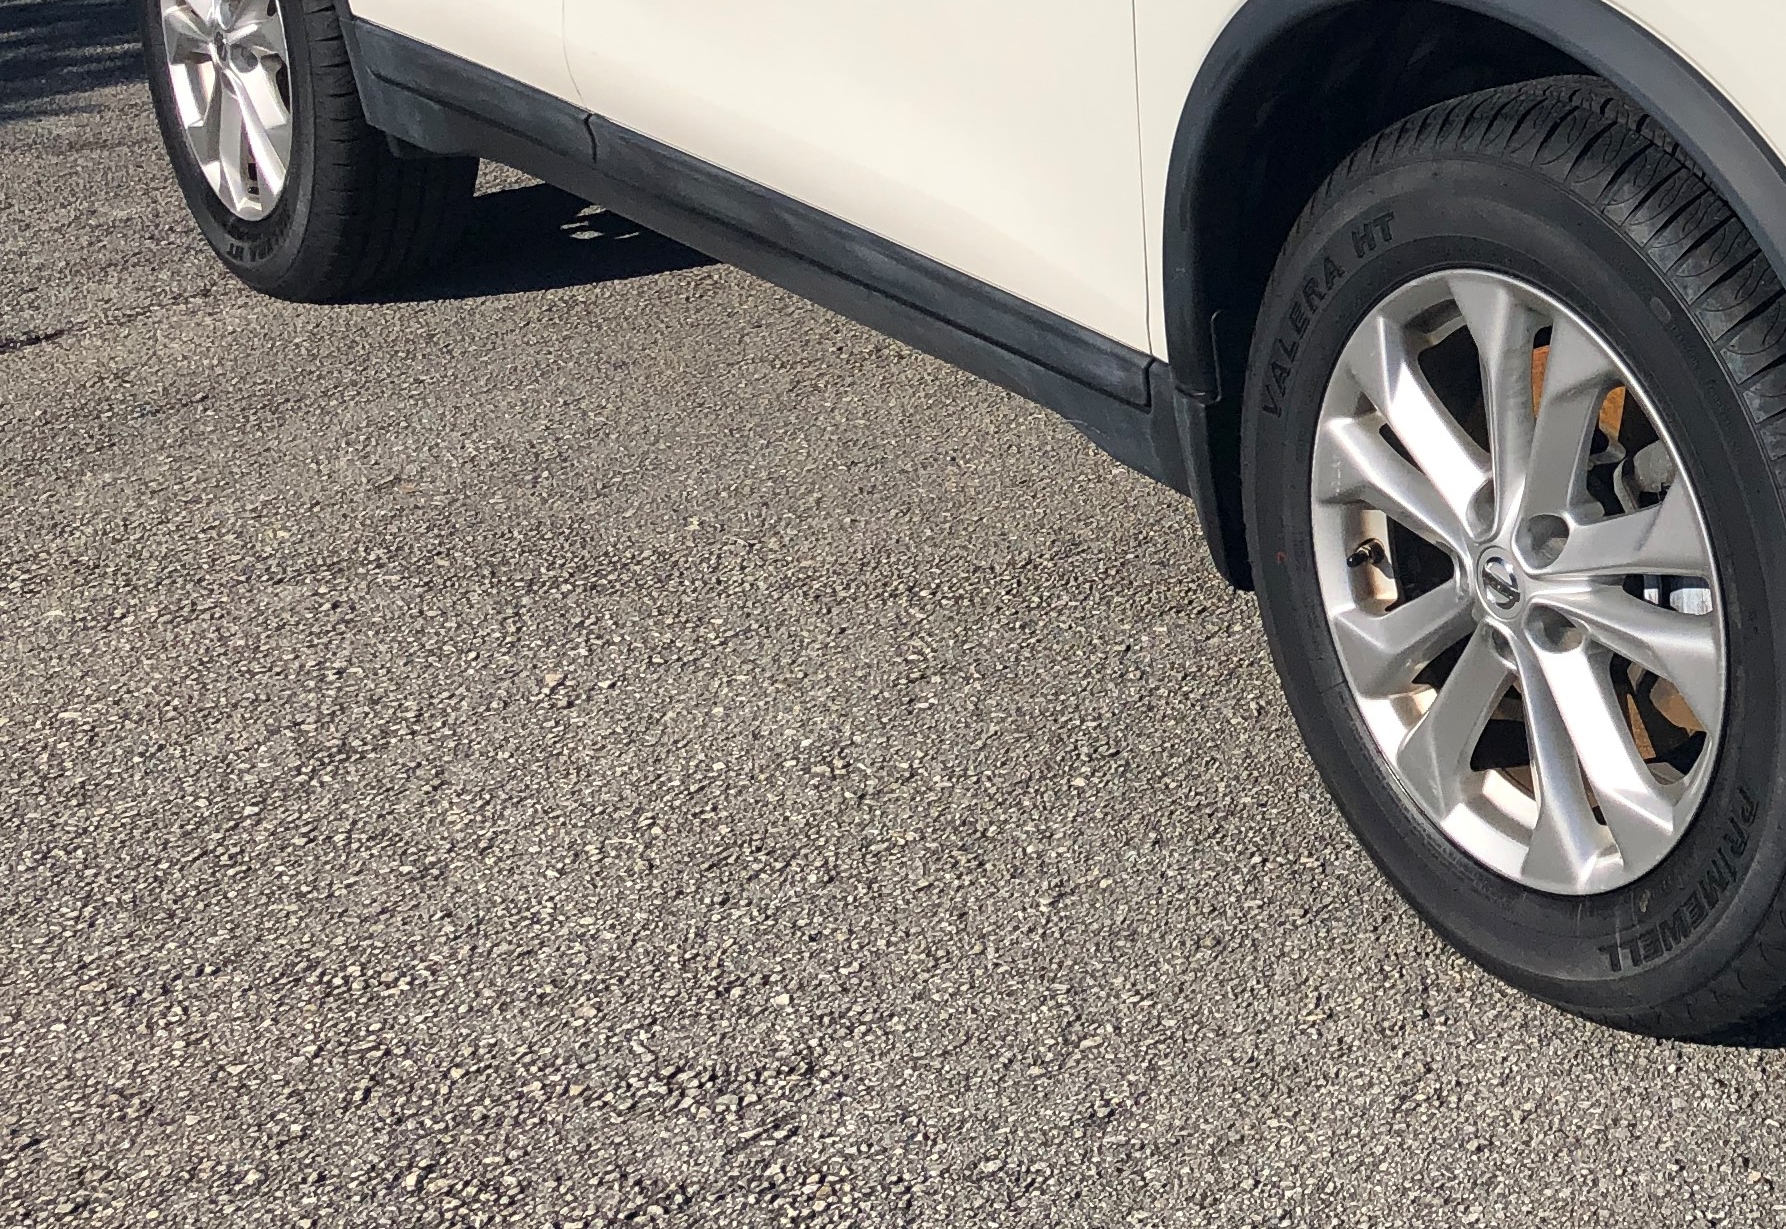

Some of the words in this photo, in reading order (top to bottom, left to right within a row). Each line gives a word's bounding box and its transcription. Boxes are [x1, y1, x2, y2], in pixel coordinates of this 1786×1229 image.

[1261, 255, 1347, 419] VALERA
[1351, 210, 1394, 260] HT
[1597, 786, 1759, 973] PRIMEWELL
